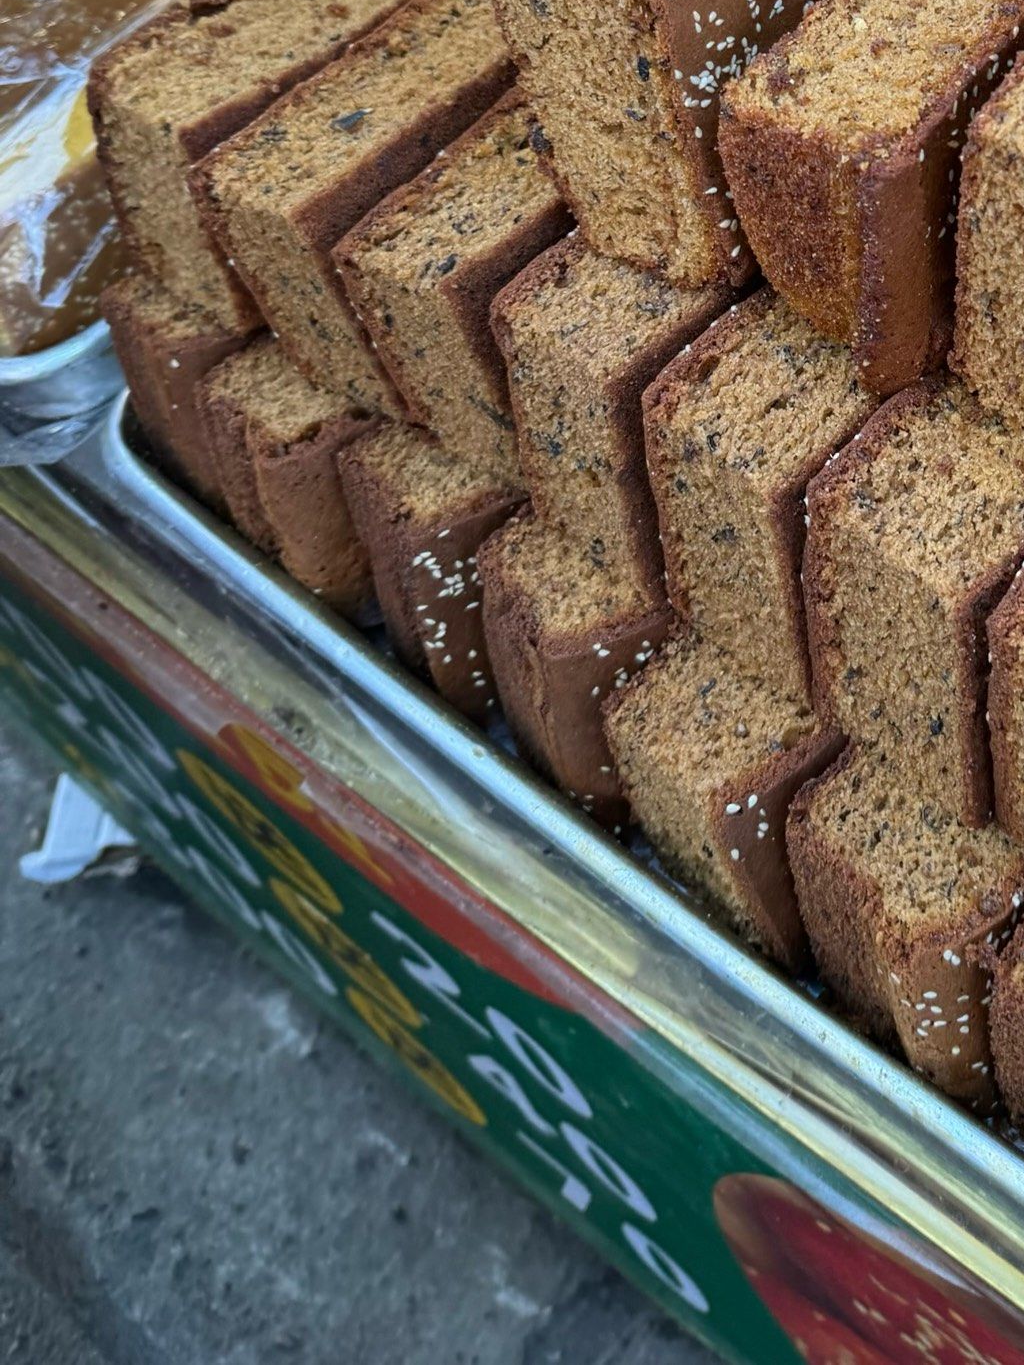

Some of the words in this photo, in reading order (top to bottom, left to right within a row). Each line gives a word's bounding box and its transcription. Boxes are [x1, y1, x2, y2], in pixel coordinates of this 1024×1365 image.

[369, 910, 593, 1120] 20
[467, 1054, 658, 1223] 40
[516, 1129, 710, 1313] 70
